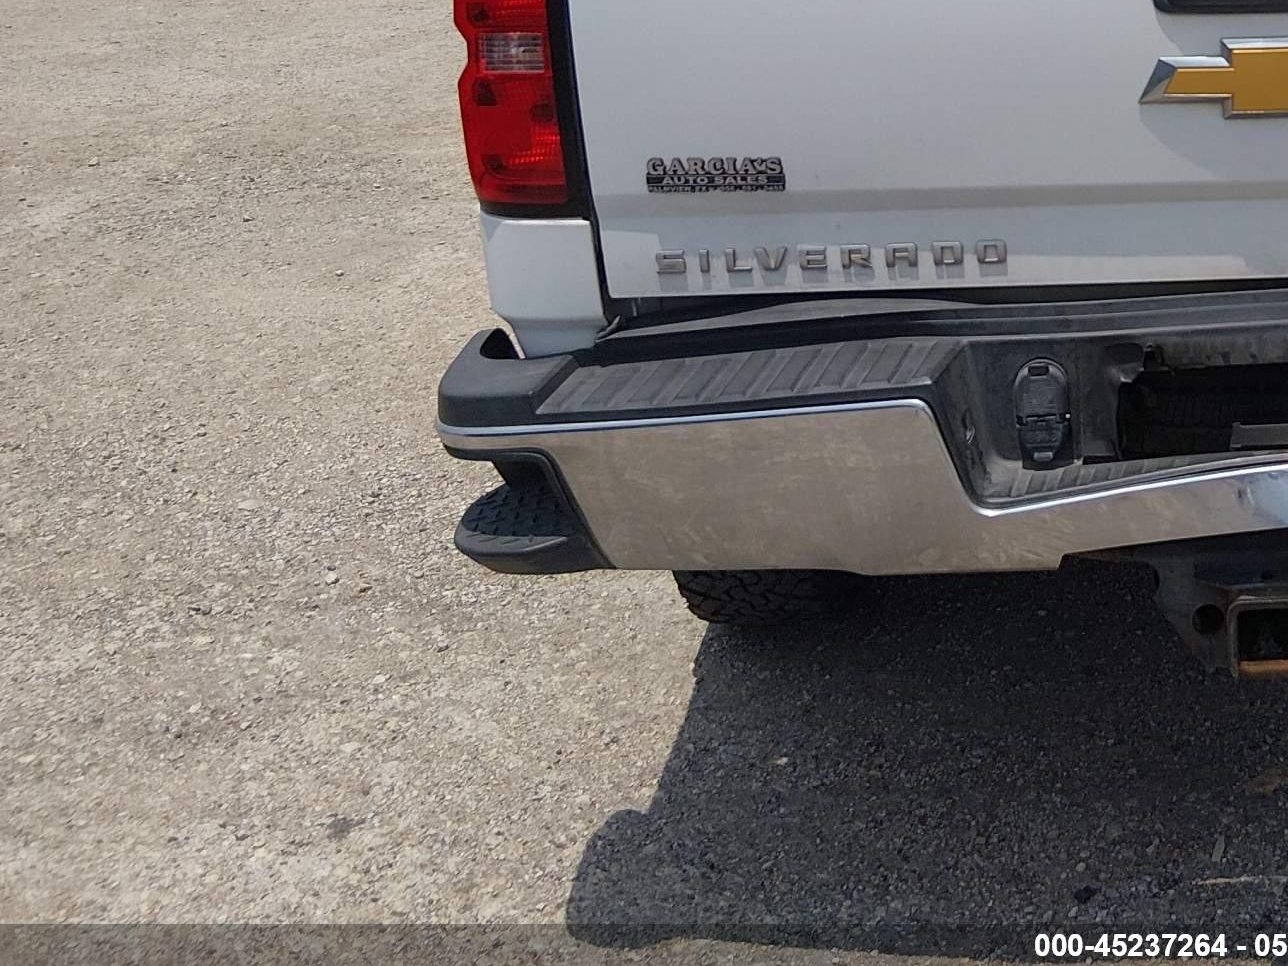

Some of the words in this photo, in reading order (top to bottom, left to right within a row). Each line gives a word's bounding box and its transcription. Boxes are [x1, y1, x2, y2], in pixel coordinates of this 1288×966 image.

[646, 157, 783, 174] GARCIA'S
[662, 175, 708, 185] AUTO
[714, 174, 768, 184] SALES
[655, 238, 1008, 275] SILVERADO
